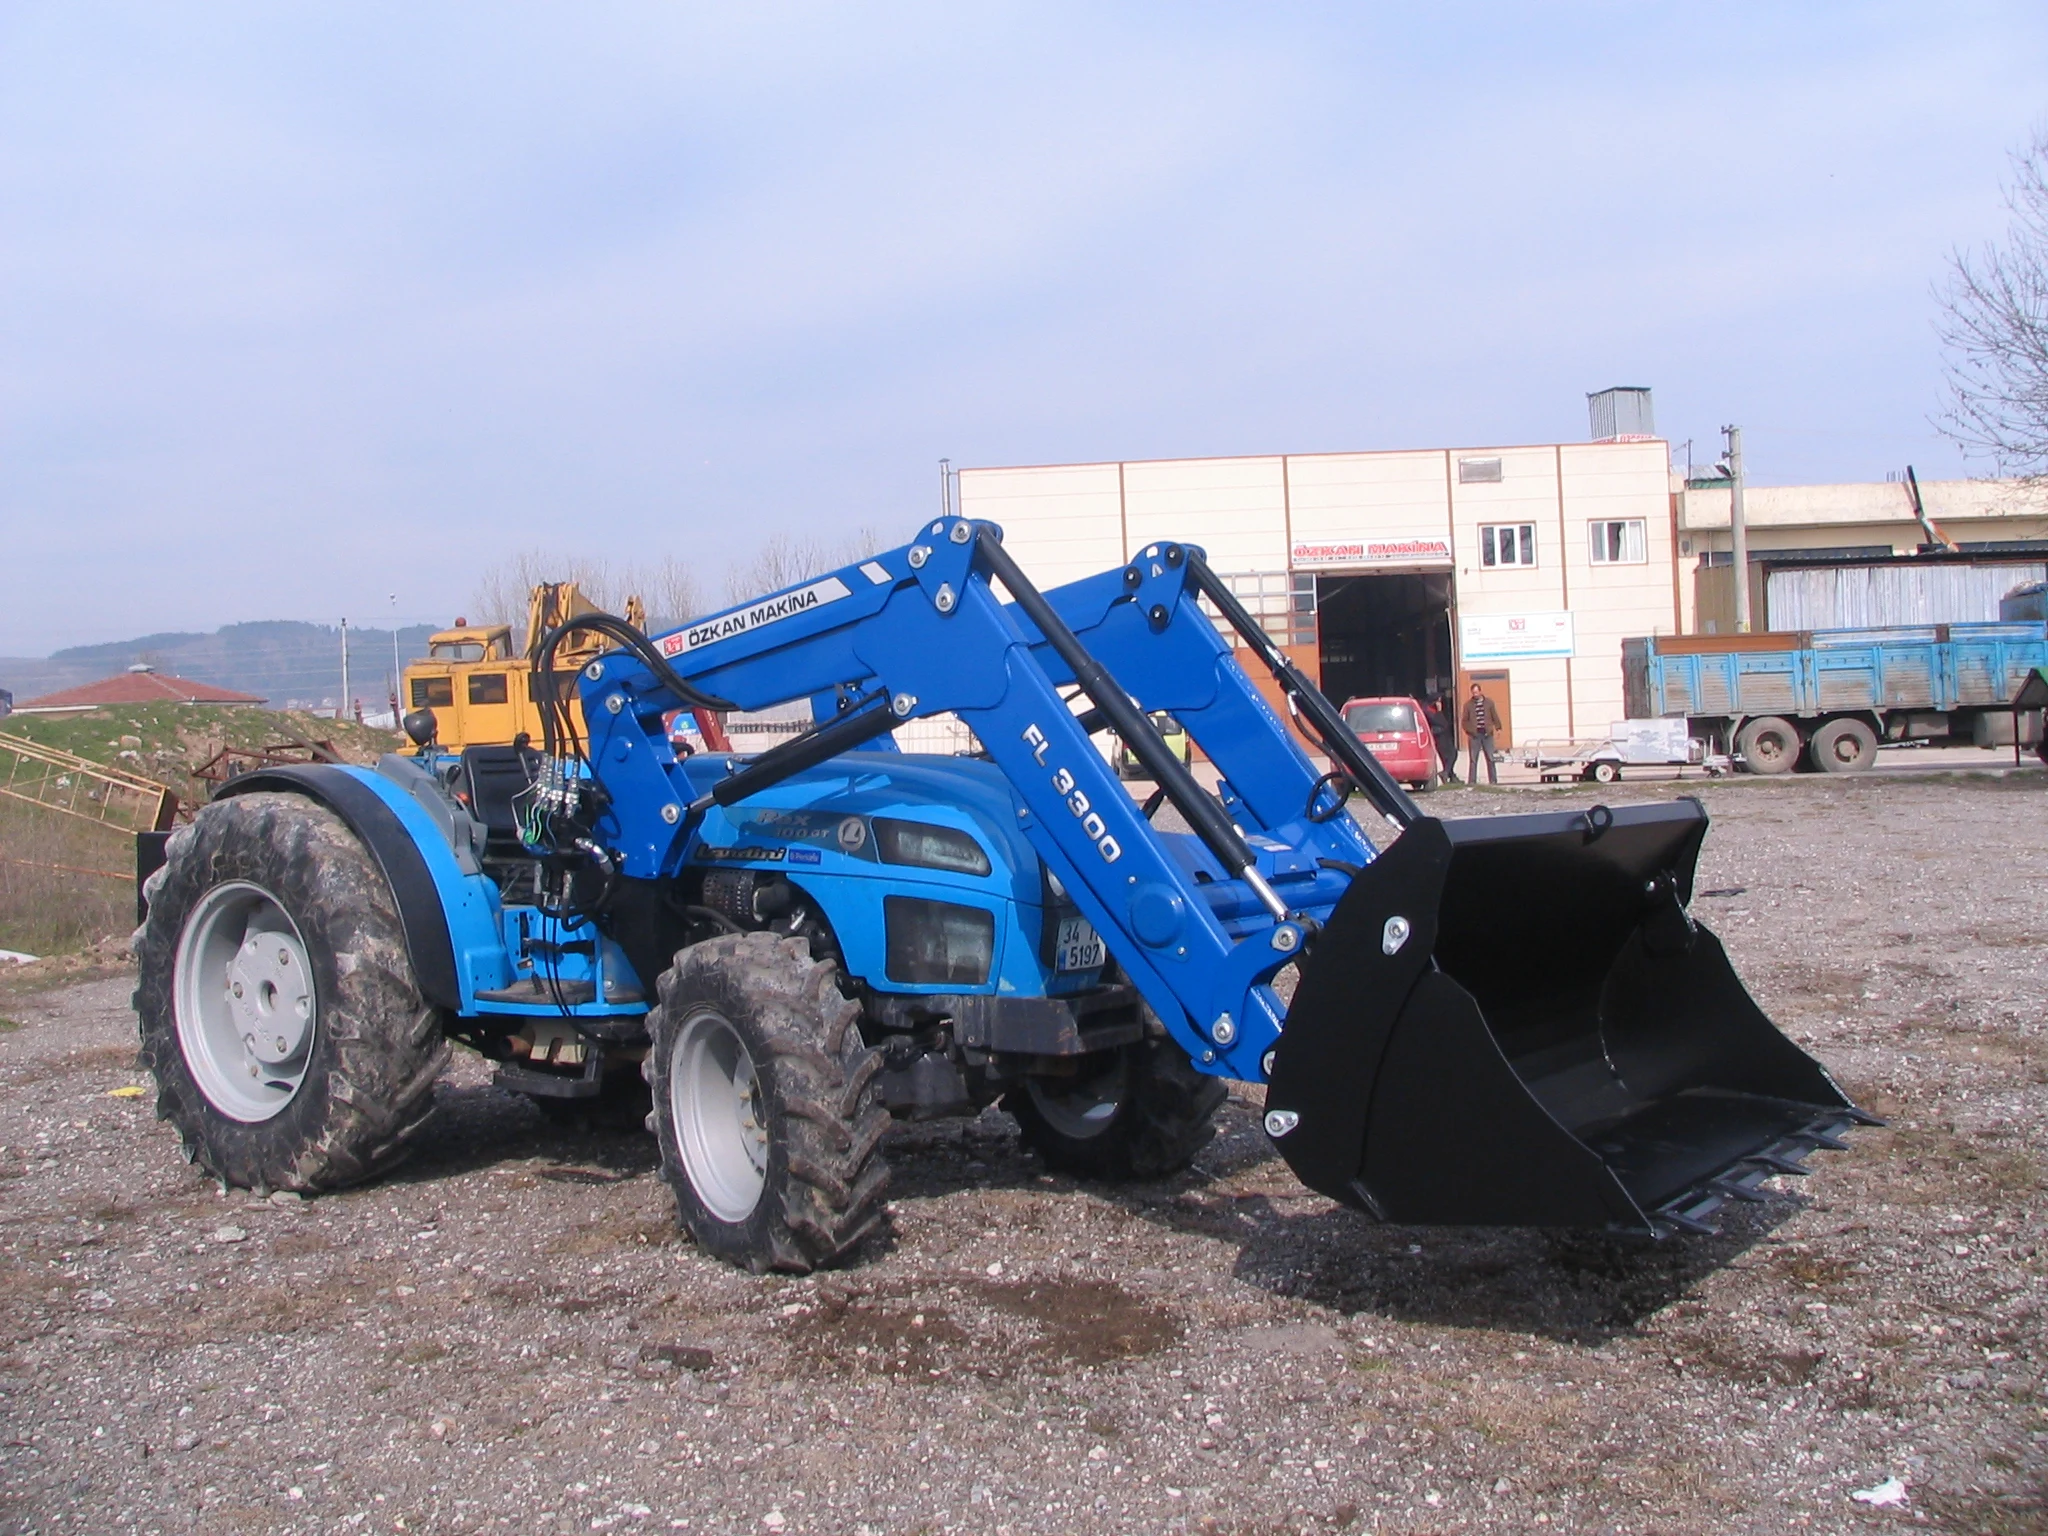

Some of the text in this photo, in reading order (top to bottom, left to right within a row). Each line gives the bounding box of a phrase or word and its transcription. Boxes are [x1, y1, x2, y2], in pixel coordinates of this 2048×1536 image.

[688, 615, 746, 647] ÖZKAN
[750, 590, 818, 626] MAKİNA
[1021, 723, 1123, 864] FL 3300
[756, 809, 812, 826] Rex
[1063, 920, 1080, 944] 34
[1070, 944, 1100, 967] 5197
